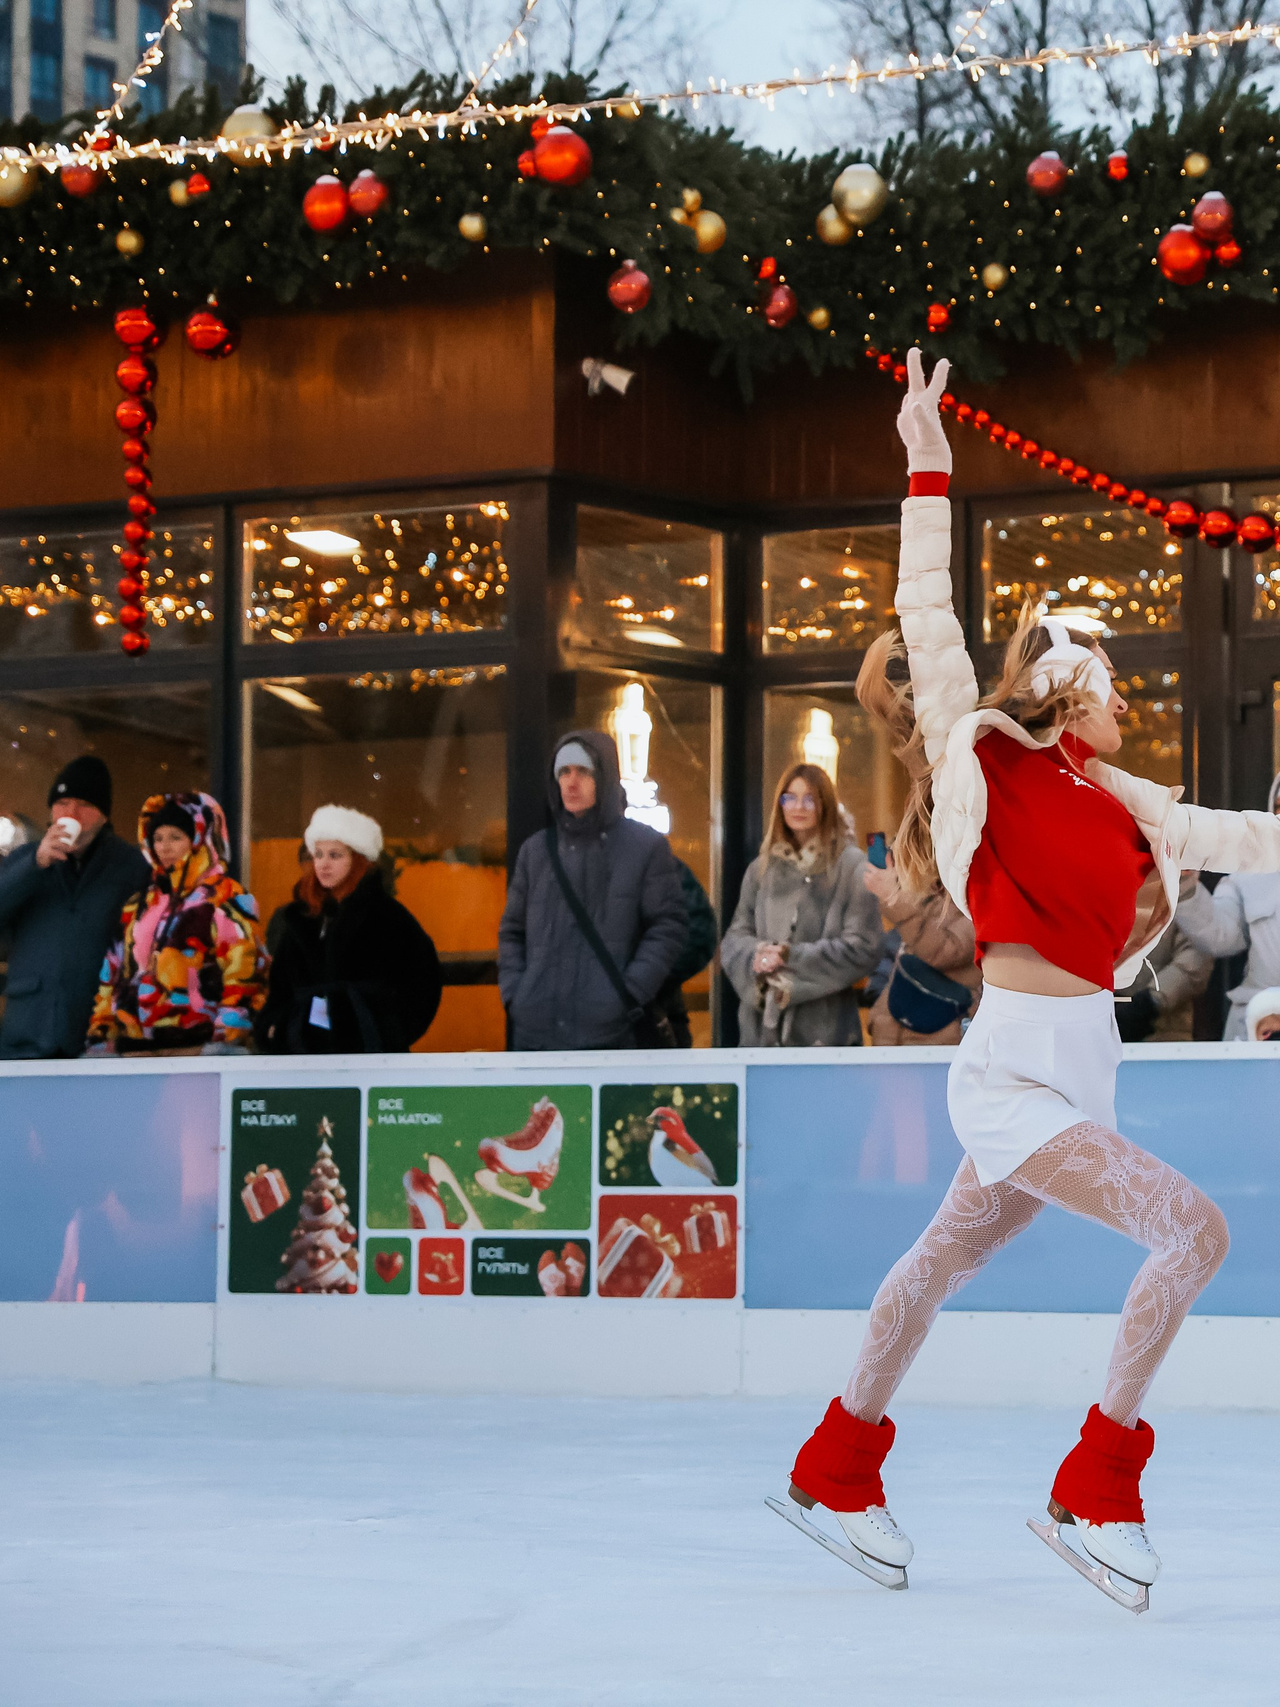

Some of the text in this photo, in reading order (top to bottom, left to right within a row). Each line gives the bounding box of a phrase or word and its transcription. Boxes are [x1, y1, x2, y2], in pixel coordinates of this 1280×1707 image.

[240, 1100, 266, 1112] ВСЕ
[378, 1099, 404, 1111] ВСЕ
[240, 1114, 258, 1126] НА
[378, 1113, 397, 1125] НА
